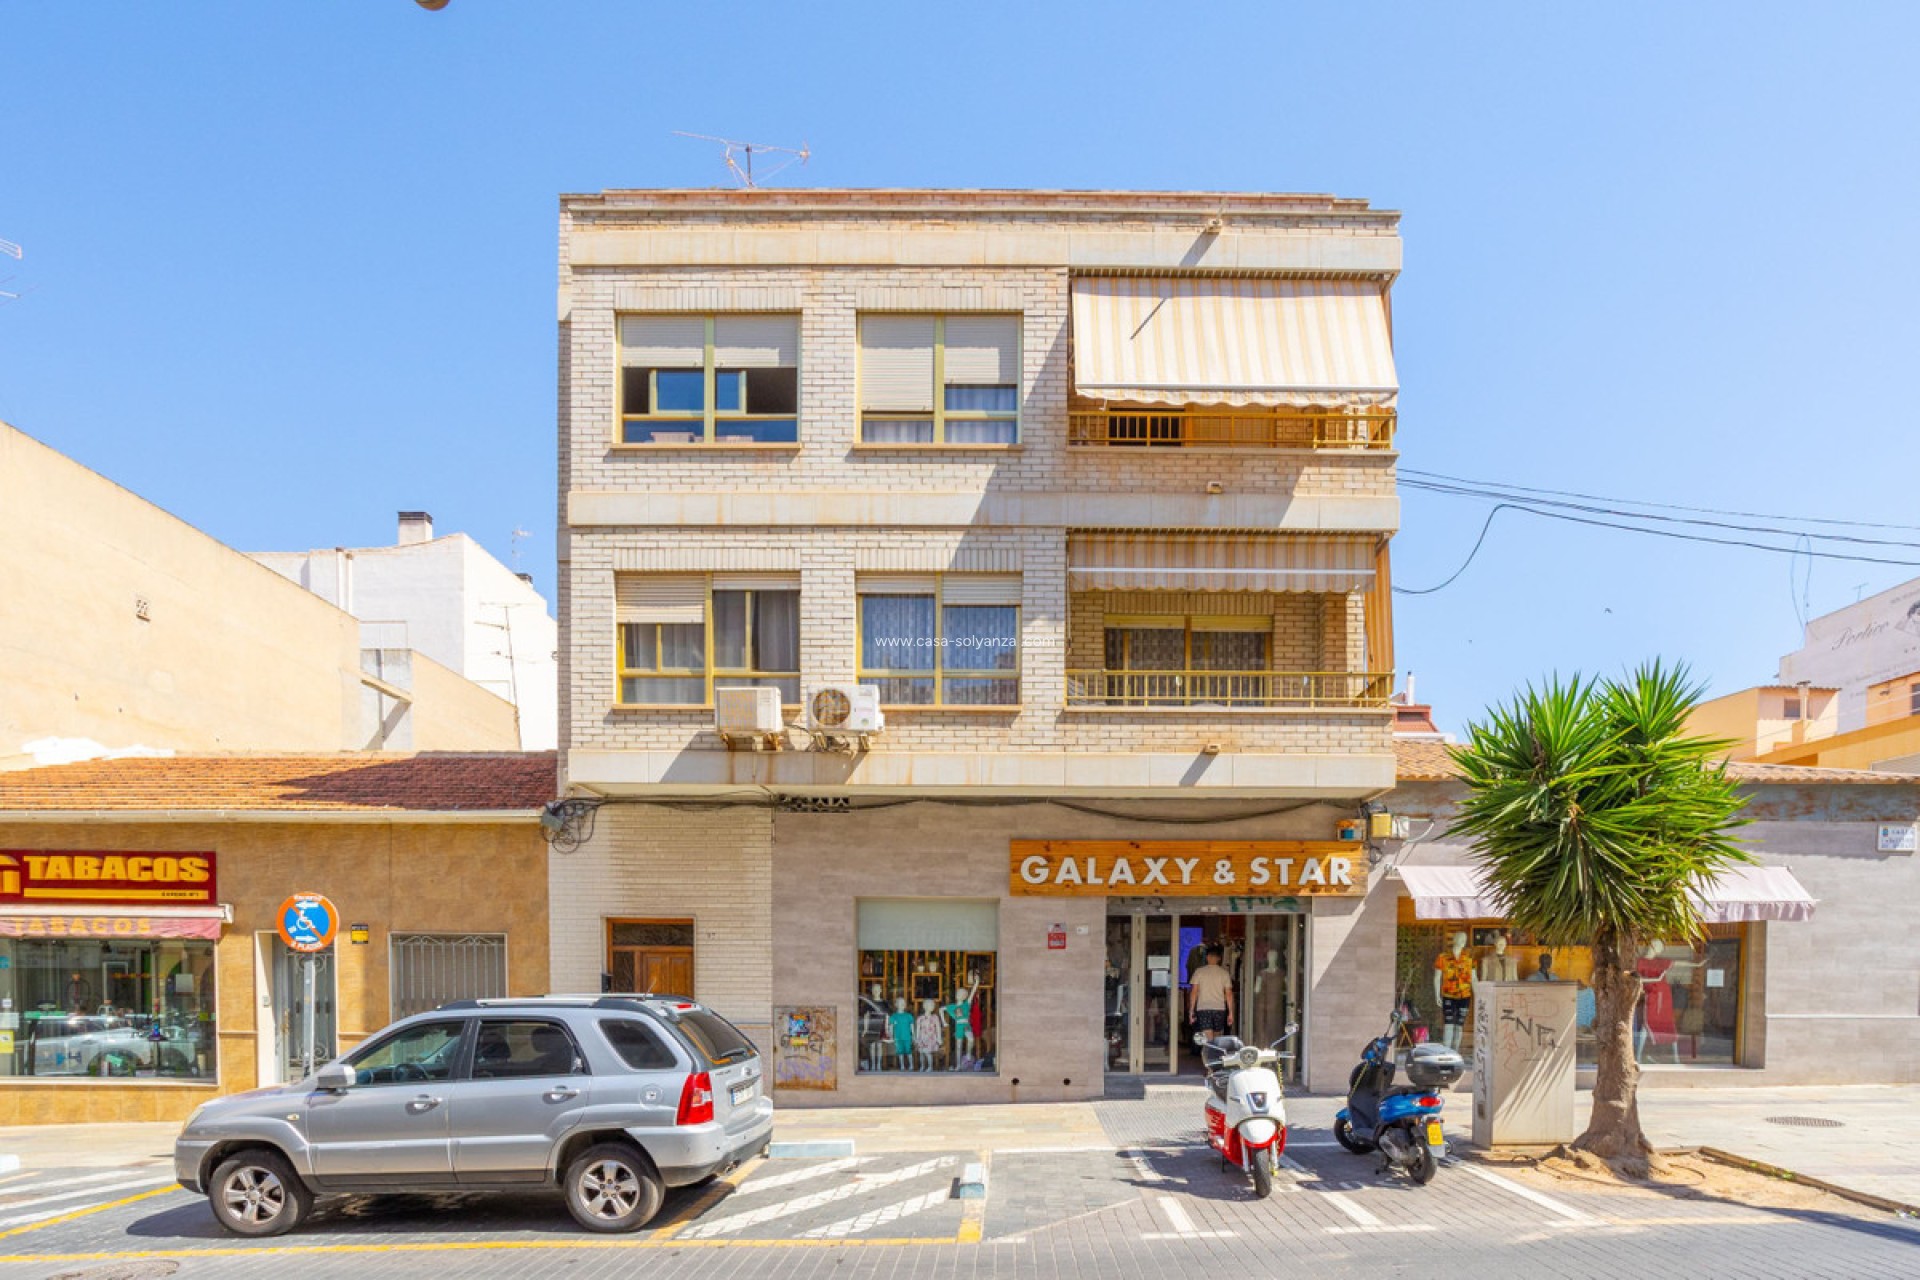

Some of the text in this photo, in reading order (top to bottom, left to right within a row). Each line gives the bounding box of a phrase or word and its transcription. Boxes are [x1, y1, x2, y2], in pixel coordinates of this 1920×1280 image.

[23, 855, 210, 883] TABACOS
[1020, 855, 1353, 886] GALAXY & STAR
[14, 916, 152, 935] TABACOS
